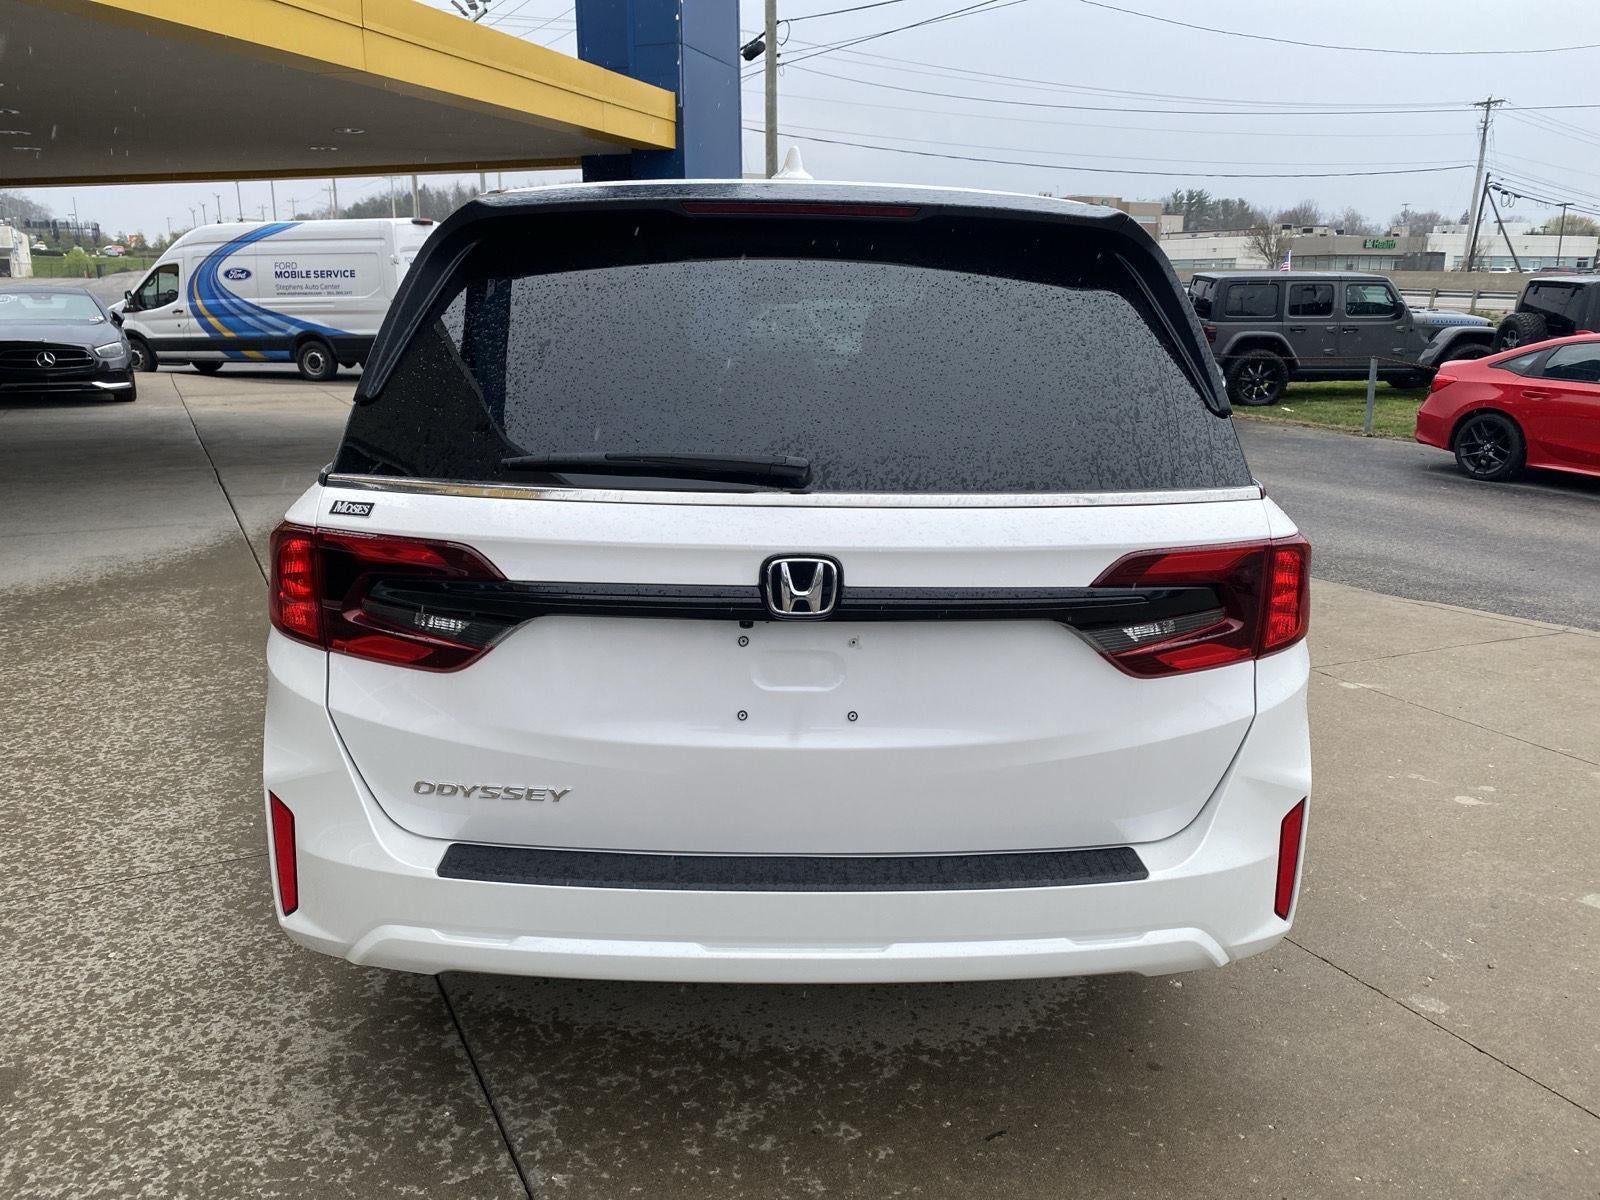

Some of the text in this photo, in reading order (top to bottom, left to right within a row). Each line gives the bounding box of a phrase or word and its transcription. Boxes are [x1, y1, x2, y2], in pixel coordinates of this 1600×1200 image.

[274, 261, 298, 270] FORD
[228, 269, 247, 279] Ford
[274, 269, 356, 279] MOBILE SERVICE
[275, 283, 304, 291] Stephens
[413, 780, 573, 803] ODYSSEY
